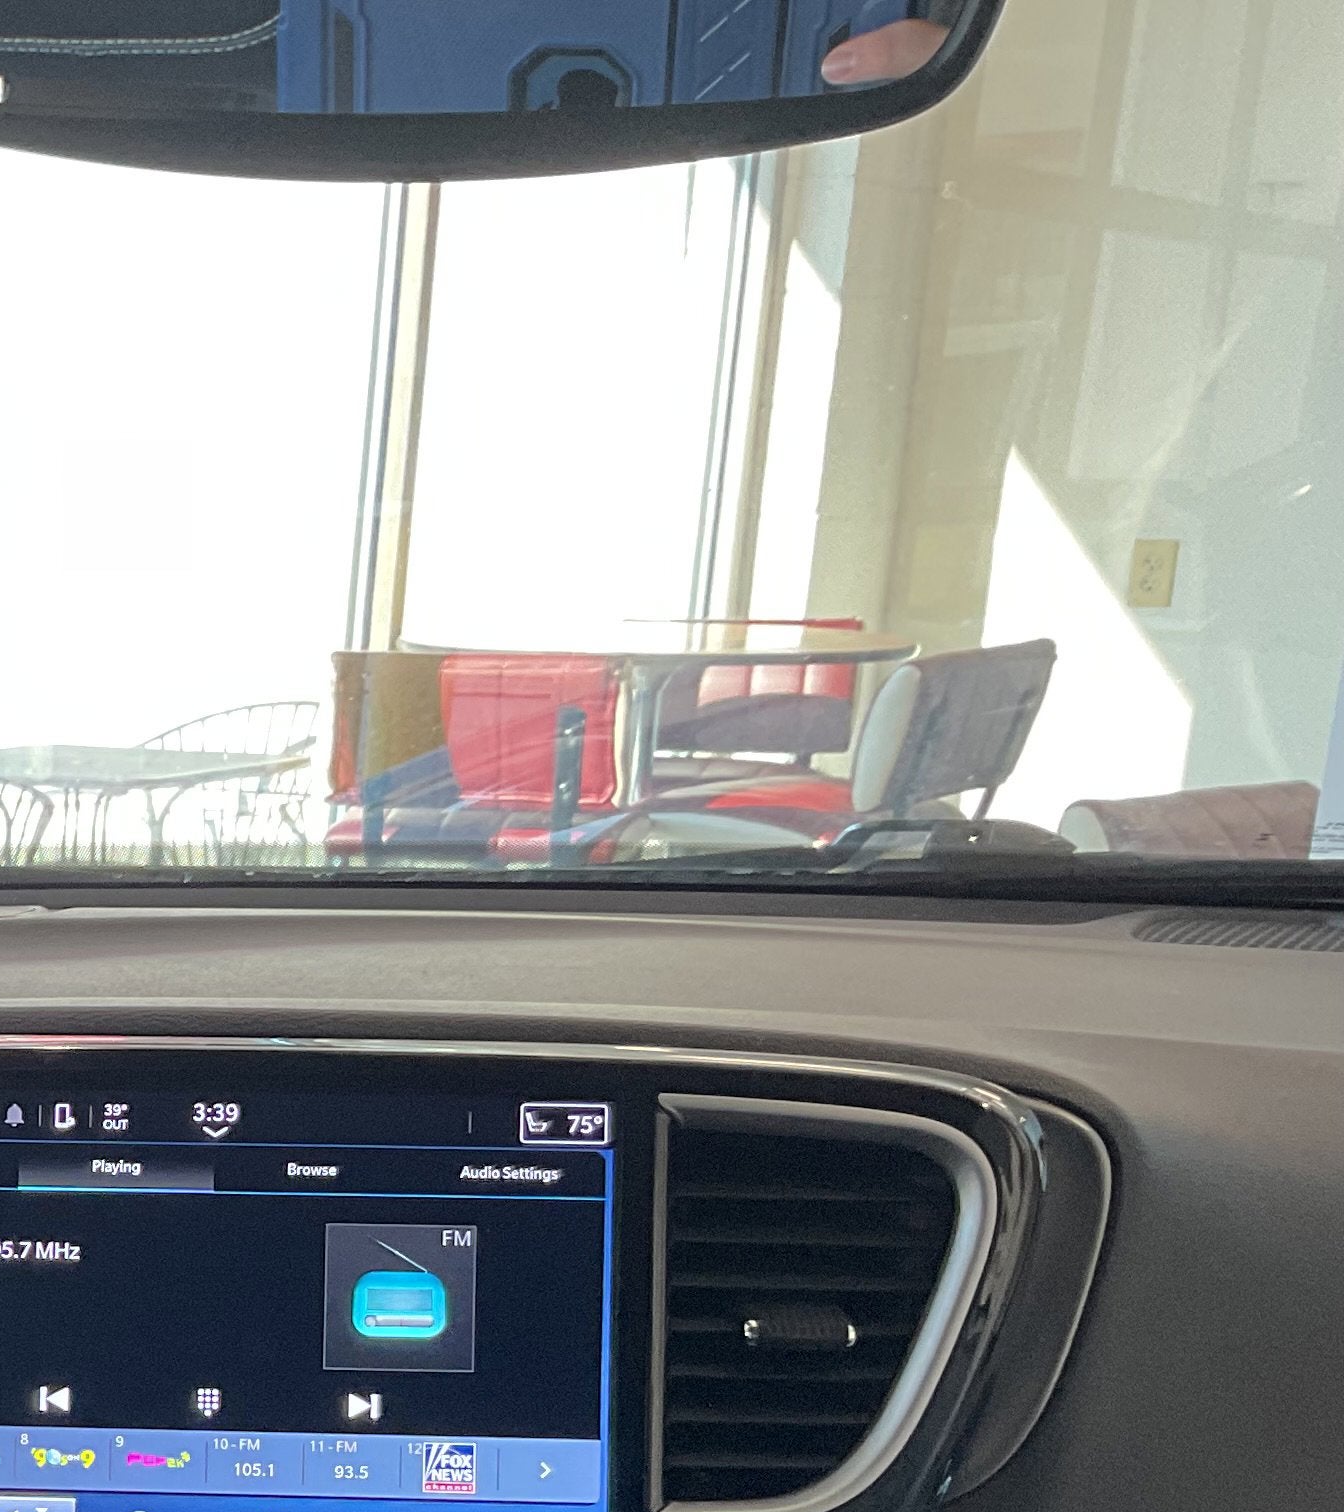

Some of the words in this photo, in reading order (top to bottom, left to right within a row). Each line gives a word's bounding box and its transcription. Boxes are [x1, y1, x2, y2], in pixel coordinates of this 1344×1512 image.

[102, 1103, 129, 1117] 39°
[192, 1102, 240, 1123] 3:39
[102, 1119, 129, 1131] OUT
[91, 1158, 142, 1177] Playing
[286, 1161, 338, 1177] Browse
[459, 1165, 501, 1180] Audio
[502, 1166, 559, 1184] Settings
[442, 1229, 472, 1247] FM
[34, 1241, 82, 1261] MHz
[20, 1433, 30, 1446] 8
[115, 1435, 125, 1448] 9
[212, 1437, 230, 1451] 10
[239, 1438, 261, 1452] FM
[309, 1439, 325, 1453] 11
[335, 1440, 358, 1454] FM
[407, 1442, 423, 1456] 12
[440, 1454, 473, 1469] FOX
[233, 1462, 276, 1478] 105.1
[333, 1464, 370, 1480] 93.5
[430, 1468, 474, 1482] NEWS
